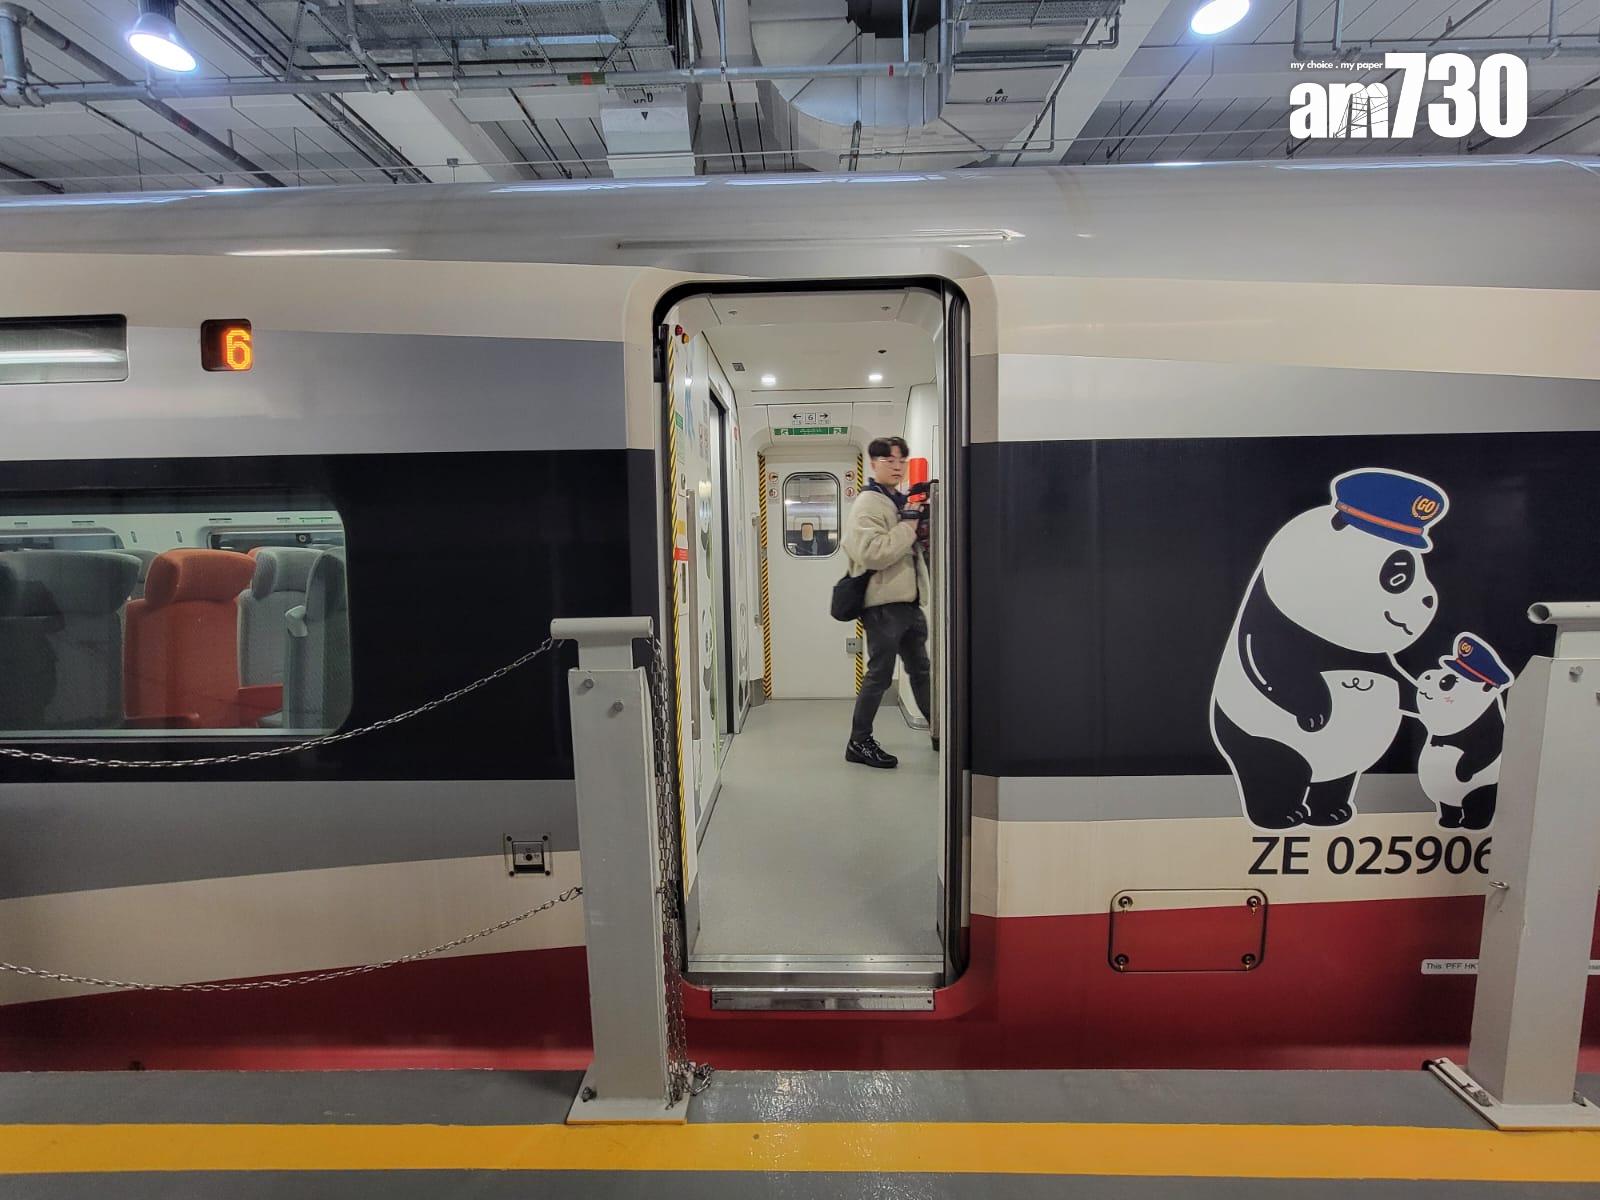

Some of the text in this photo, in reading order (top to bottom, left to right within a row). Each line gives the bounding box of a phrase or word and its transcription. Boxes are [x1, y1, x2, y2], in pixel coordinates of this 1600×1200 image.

[226, 329, 251, 370] 6
[1417, 498, 1436, 513] GO
[1248, 835, 1493, 875] ZE 025906
